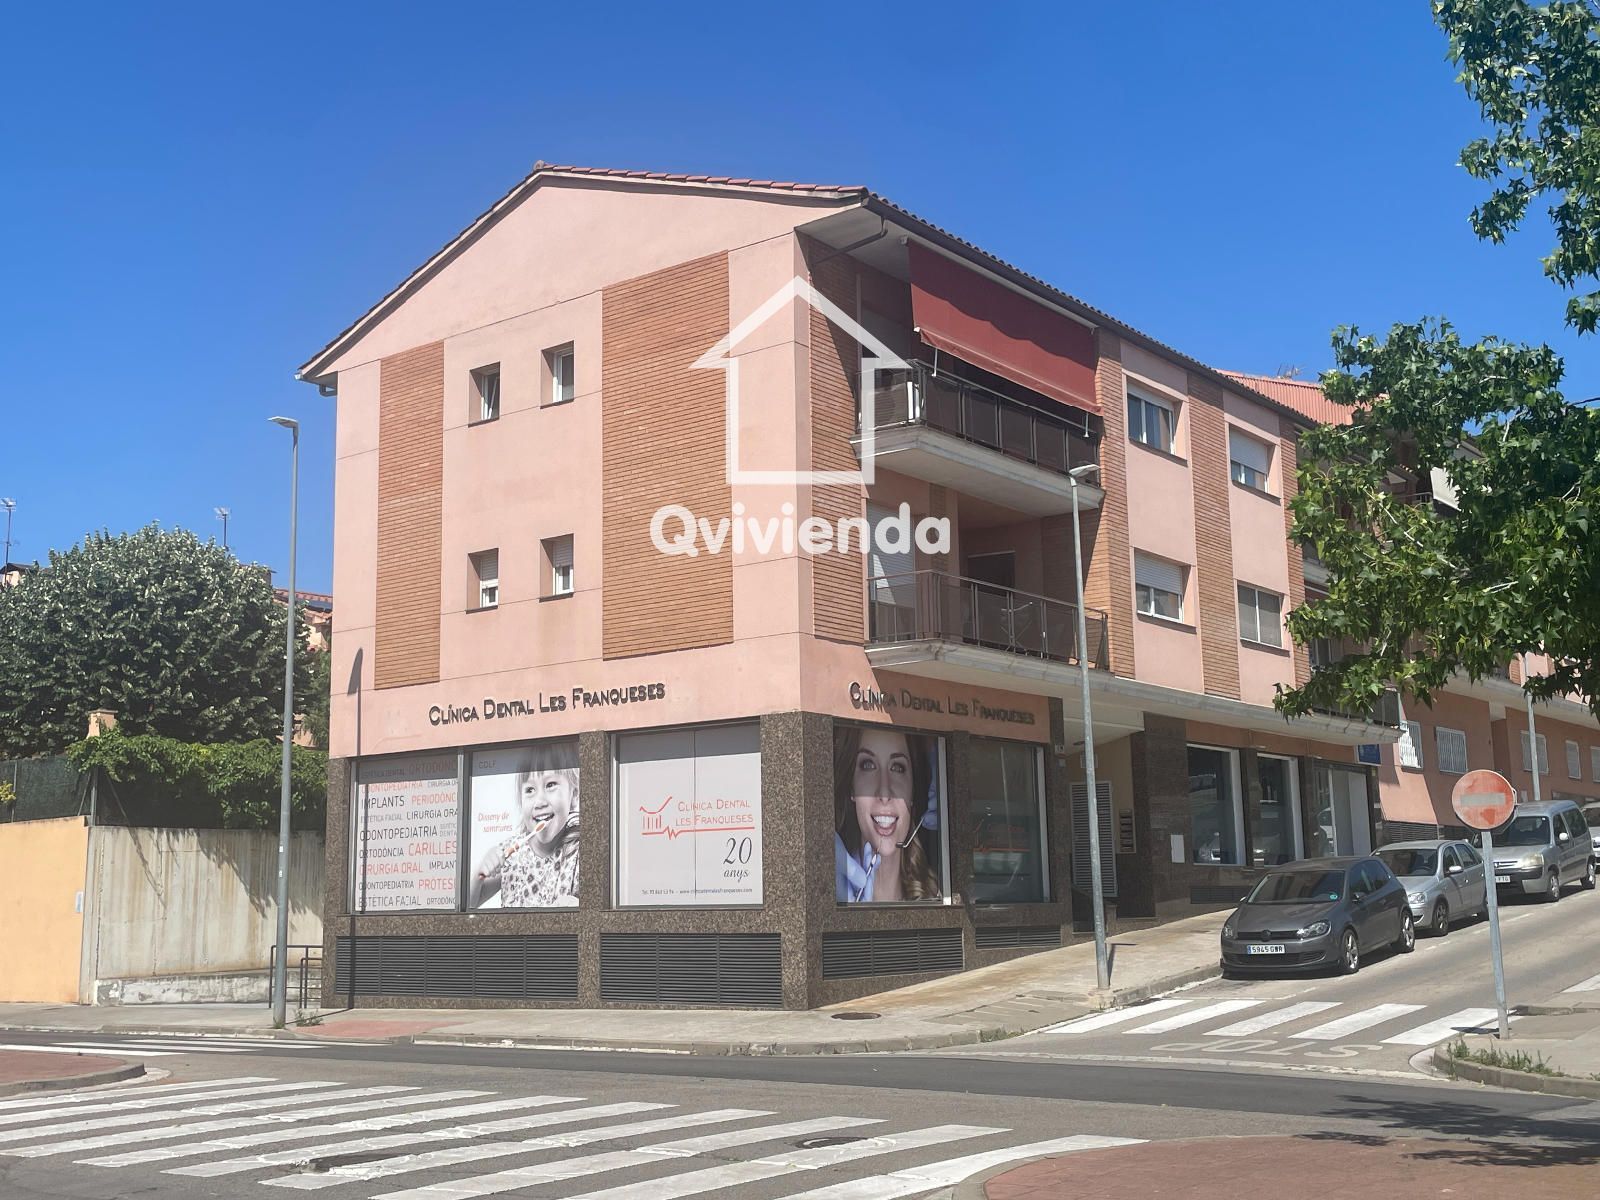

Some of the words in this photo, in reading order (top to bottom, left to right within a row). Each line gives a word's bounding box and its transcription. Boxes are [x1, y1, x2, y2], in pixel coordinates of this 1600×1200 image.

[483, 699, 534, 720] DENTAL
[539, 692, 567, 713] LES
[572, 683, 665, 709] FRANQUESES
[716, 798, 751, 810] DENTAL
[722, 836, 753, 865] 20
[723, 868, 751, 883] anys
[1149, 1038, 1384, 1058] STOP
